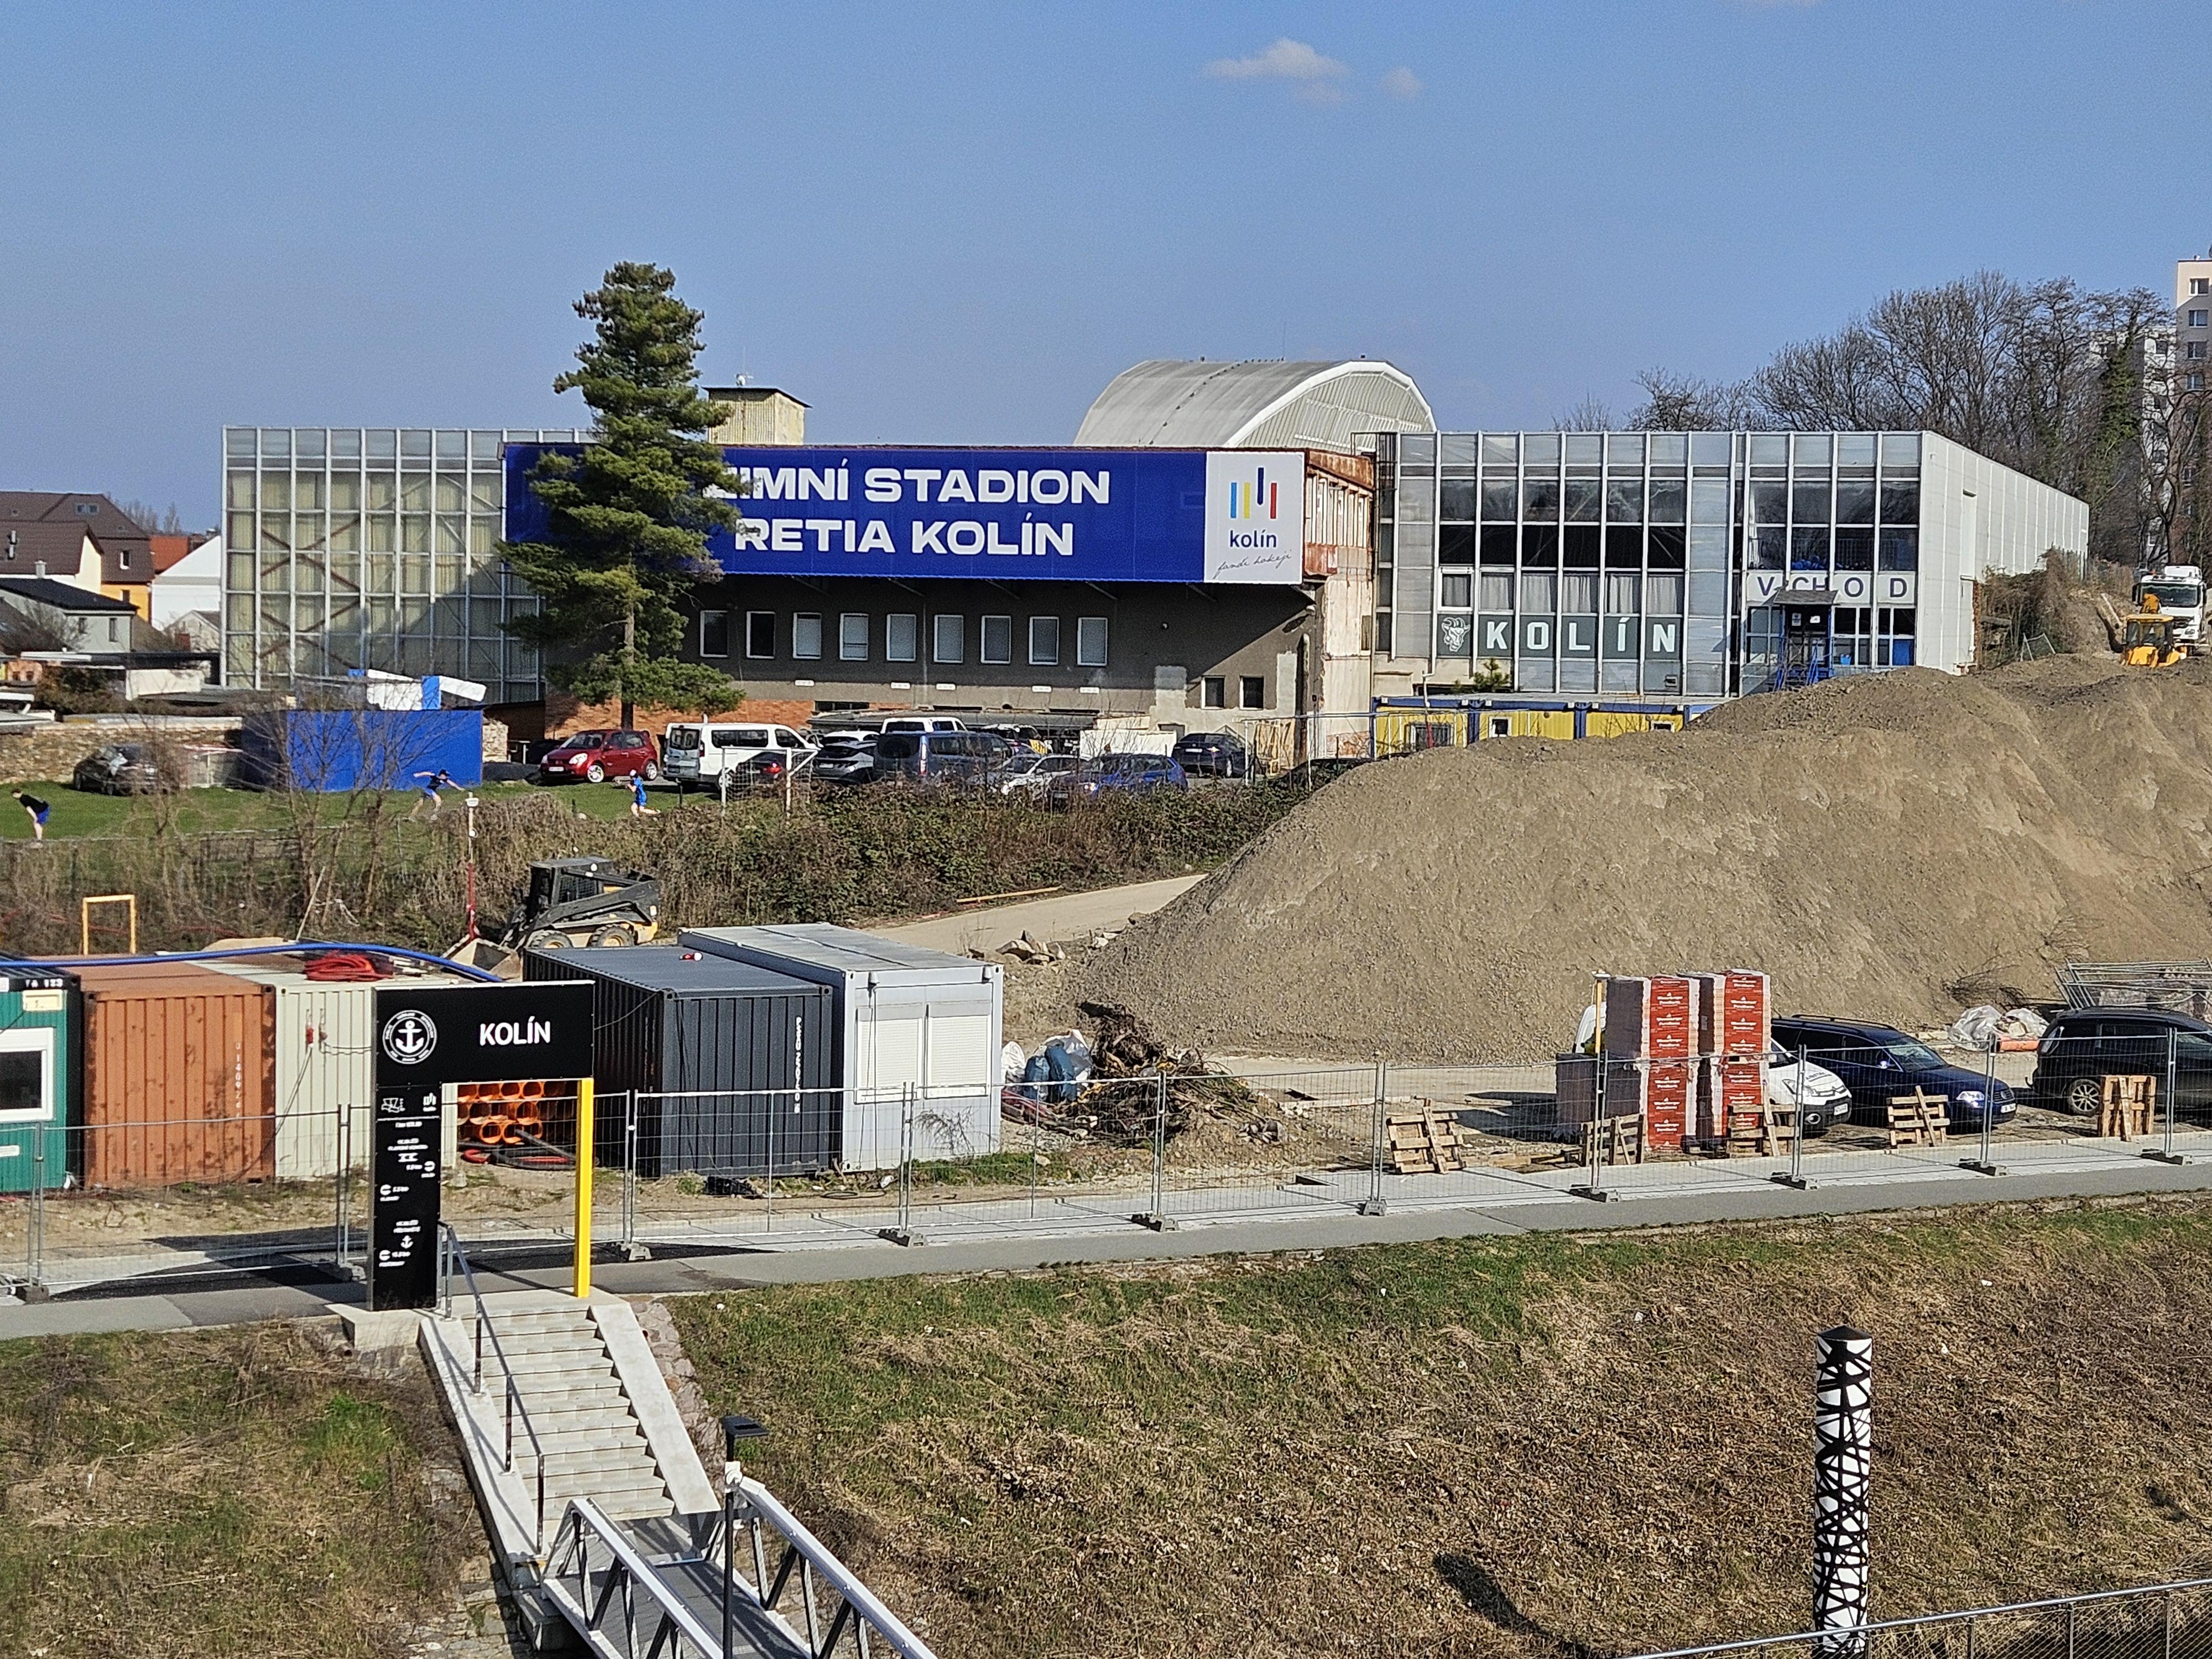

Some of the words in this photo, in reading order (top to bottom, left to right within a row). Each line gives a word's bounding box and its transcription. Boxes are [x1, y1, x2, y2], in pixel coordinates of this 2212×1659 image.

[864, 468, 1110, 504] STADION
[735, 518, 895, 553] RETIA
[911, 512, 1073, 556] KOLÍN
[1230, 529, 1277, 547] kolín
[1486, 617, 1675, 653] KOLÍN
[479, 1015, 551, 1046] KOLÍN
